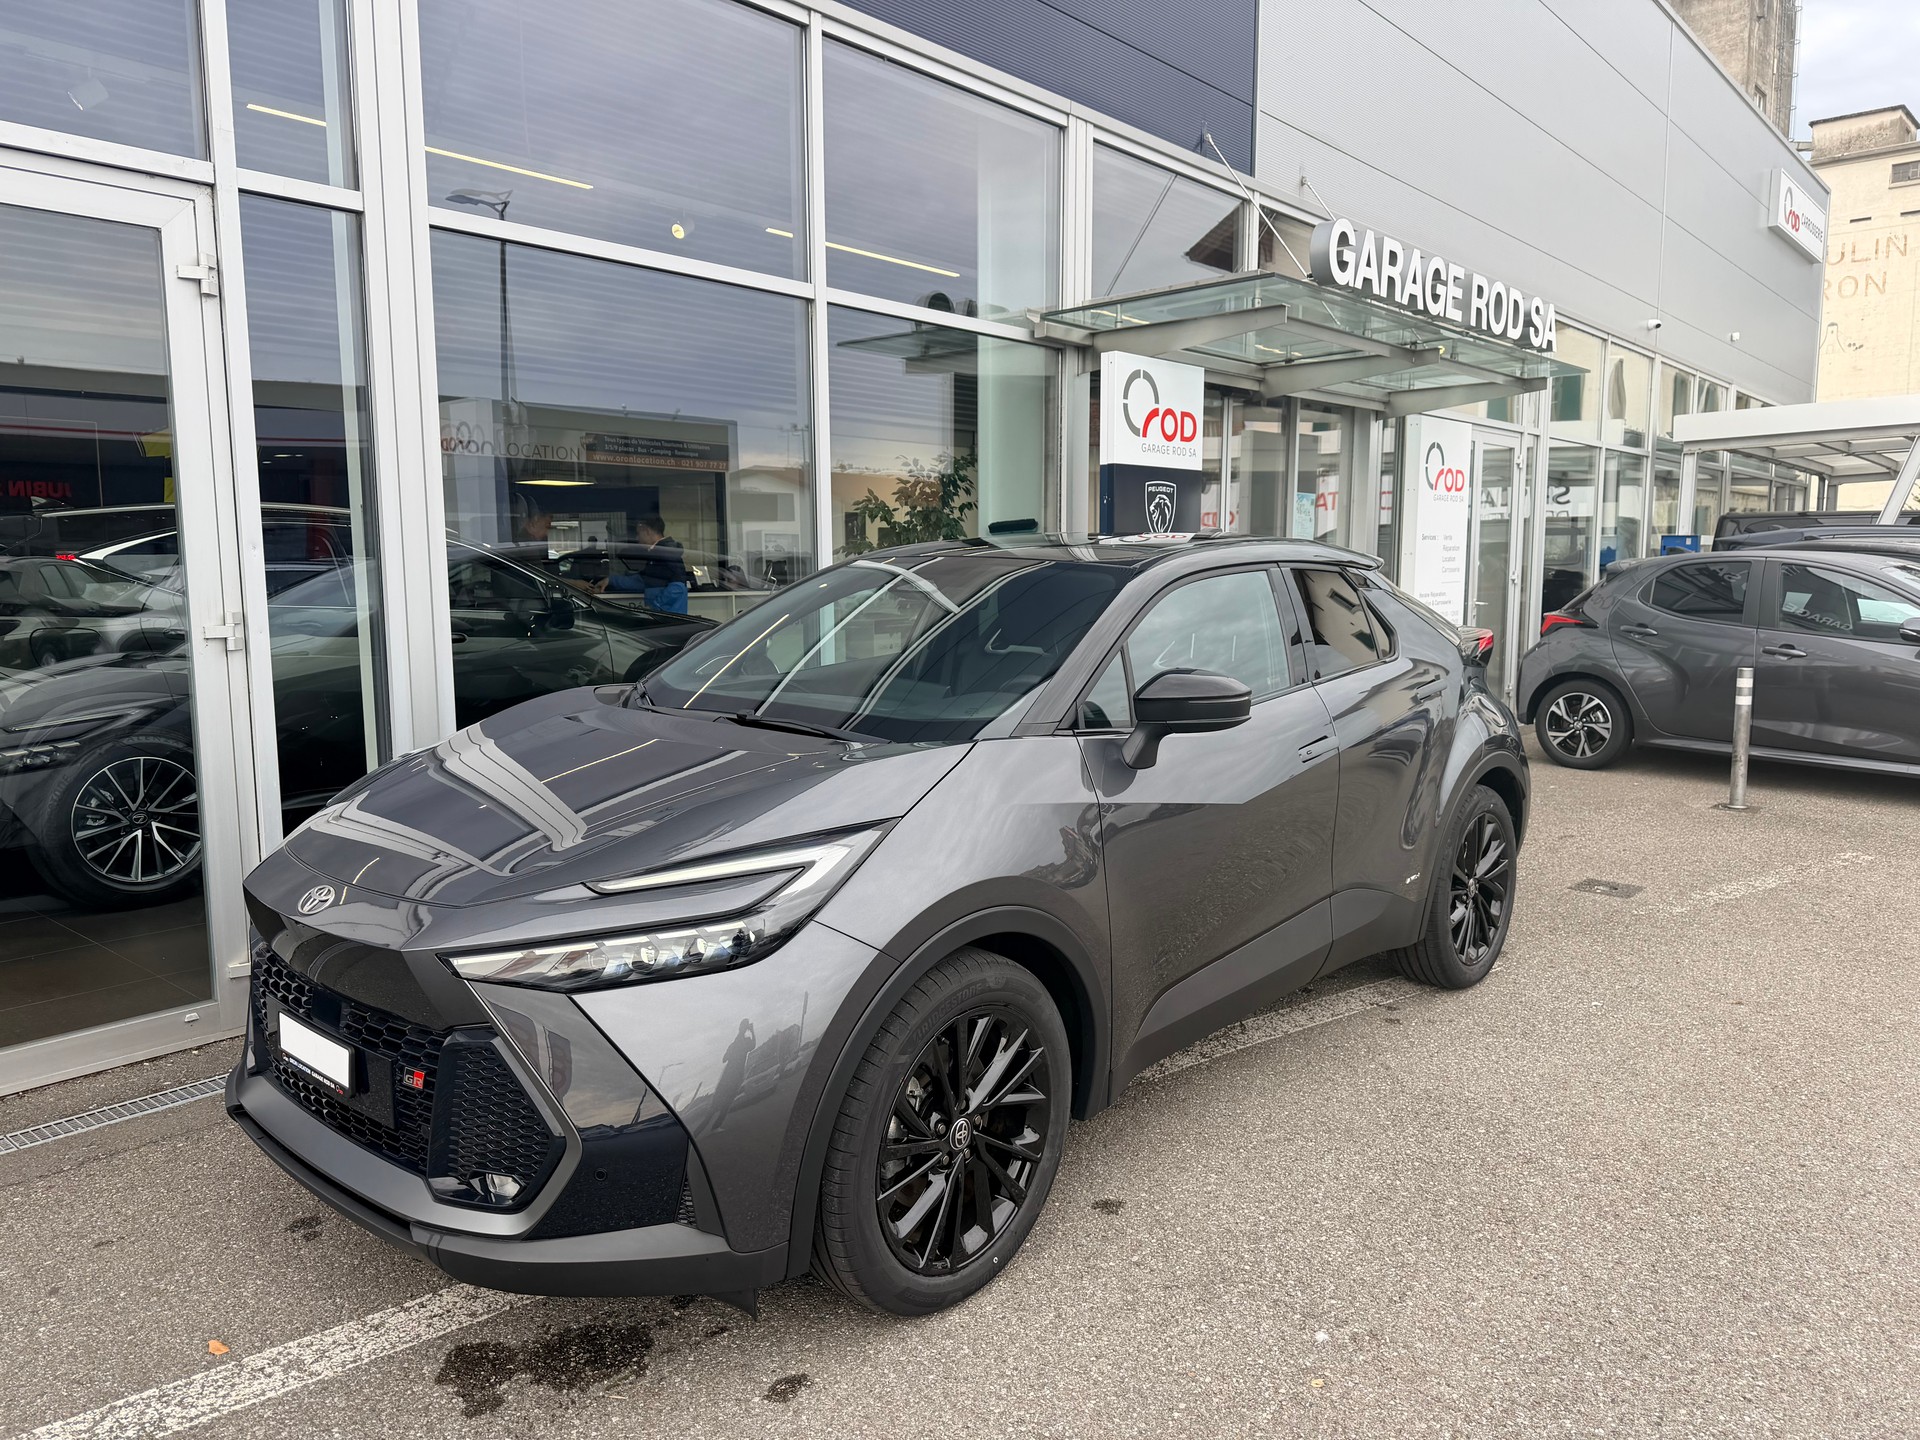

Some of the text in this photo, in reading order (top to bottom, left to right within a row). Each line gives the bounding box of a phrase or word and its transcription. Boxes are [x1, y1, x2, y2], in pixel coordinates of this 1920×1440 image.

[1329, 218, 1557, 352] GARAGE ROD SA
[1141, 443, 1197, 457] GARAGE ROD SA
[592, 453, 675, 466] www.oronlocation.ch
[1433, 494, 1449, 502] GARAGE
[405, 1074, 424, 1089] GR
